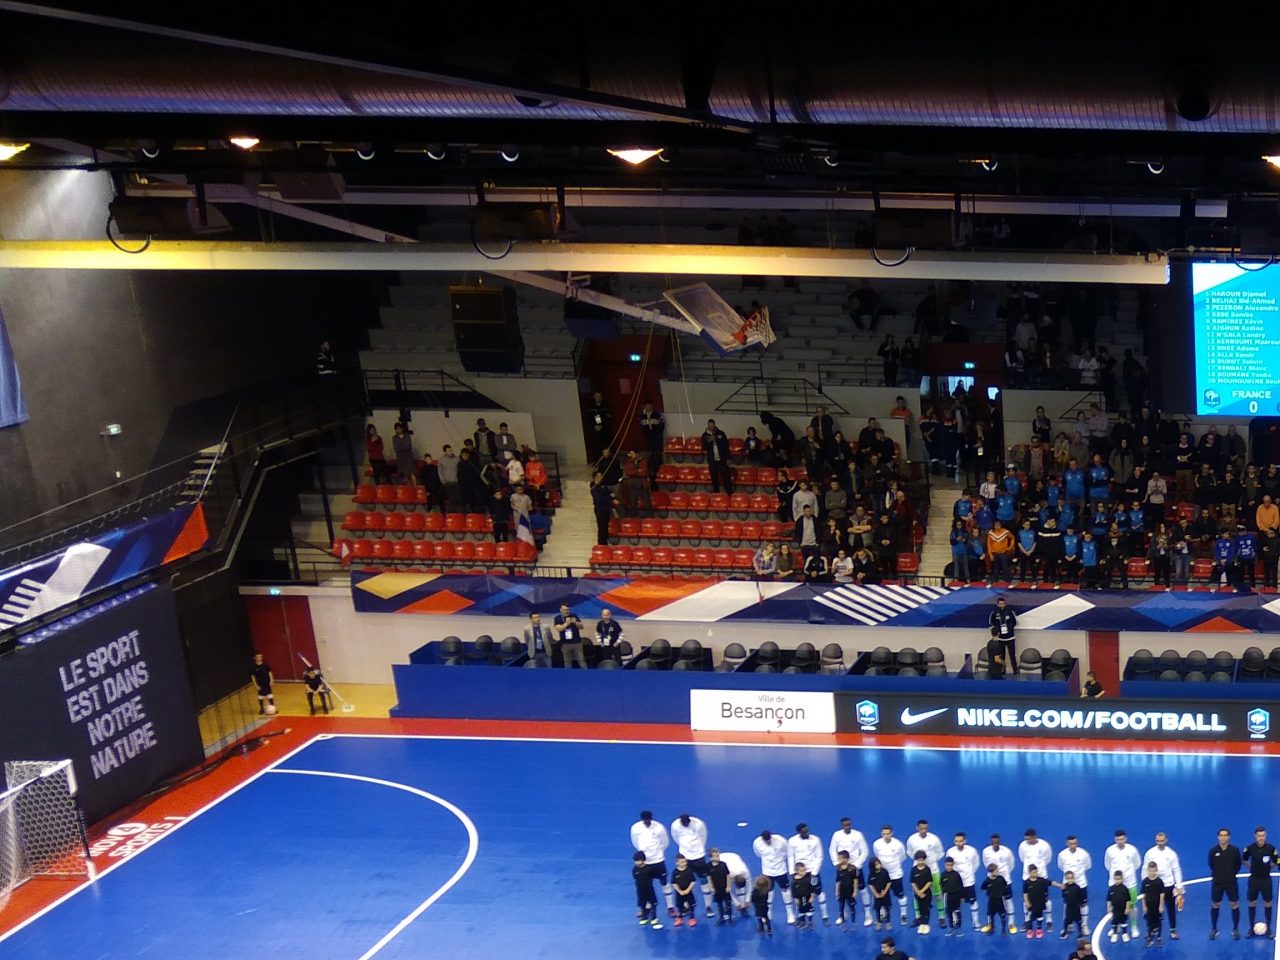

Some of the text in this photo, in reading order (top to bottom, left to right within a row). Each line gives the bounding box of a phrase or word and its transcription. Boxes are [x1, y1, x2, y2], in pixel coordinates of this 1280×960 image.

[1232, 390, 1272, 399] FRANCE
[1249, 401, 1258, 413] 0
[58, 629, 141, 692] LE SPORT
[66, 660, 150, 724] EST DANS
[758, 695, 786, 703] Ville de
[87, 695, 147, 746] NOTRE
[721, 702, 806, 728] Besançon
[957, 708, 1227, 732] NIKE.COM/FOOTBALL
[90, 722, 159, 780] NATURE
[108, 823, 175, 857] SPORTS
